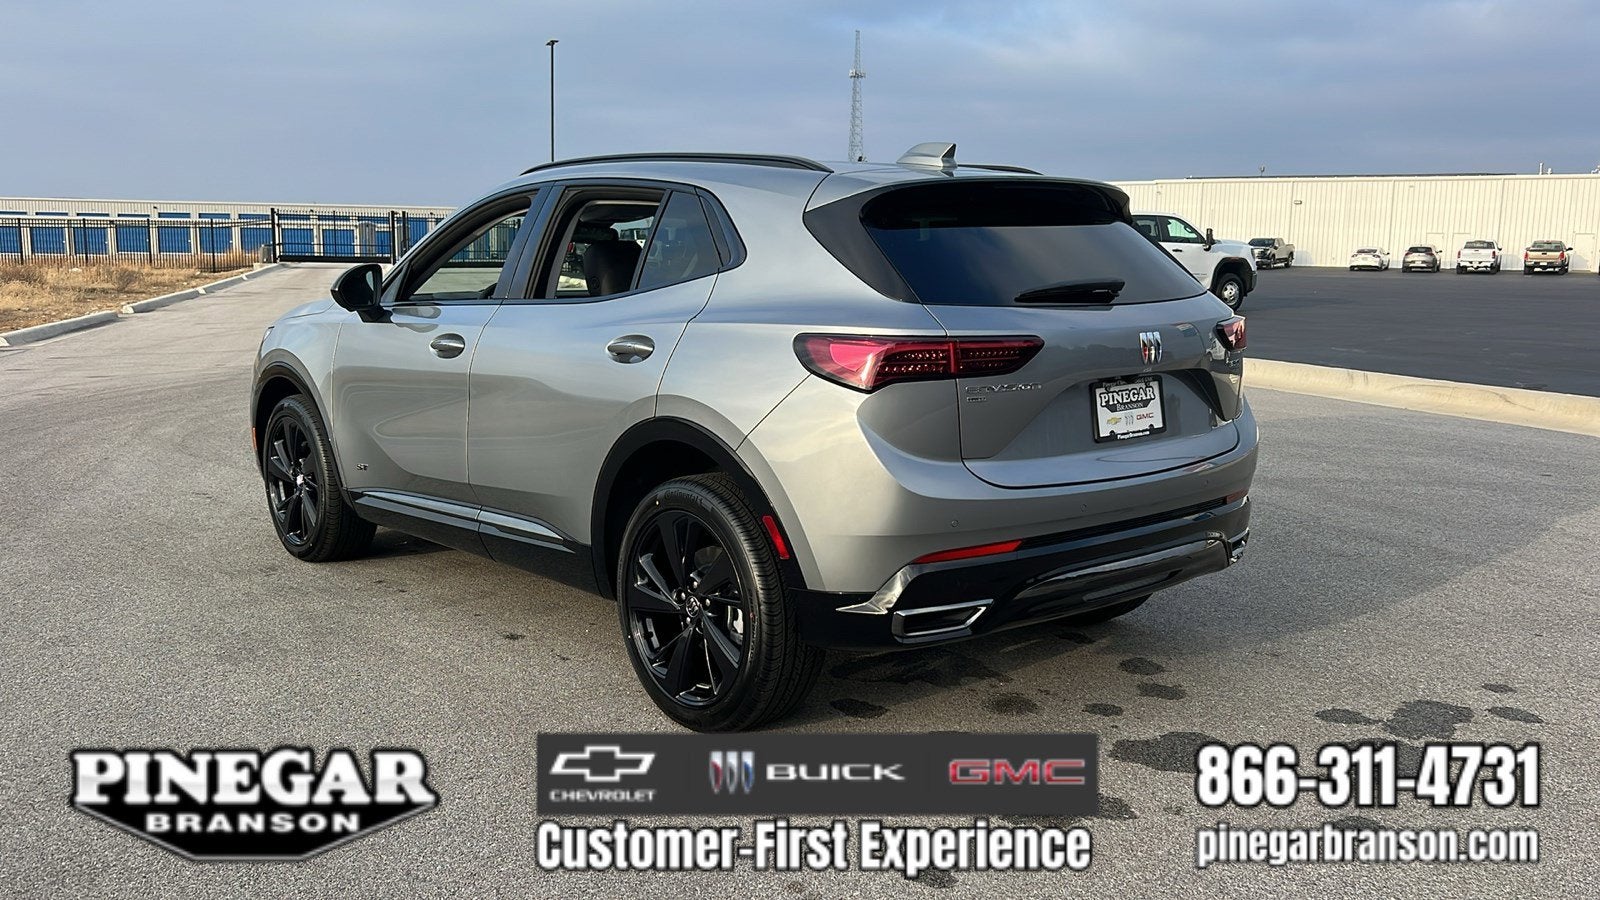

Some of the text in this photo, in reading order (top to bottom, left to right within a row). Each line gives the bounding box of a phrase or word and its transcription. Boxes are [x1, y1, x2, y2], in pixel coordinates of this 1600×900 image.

[1100, 387, 1155, 406] PINEGAR
[1136, 412, 1154, 421] GMC
[356, 463, 369, 471] ST
